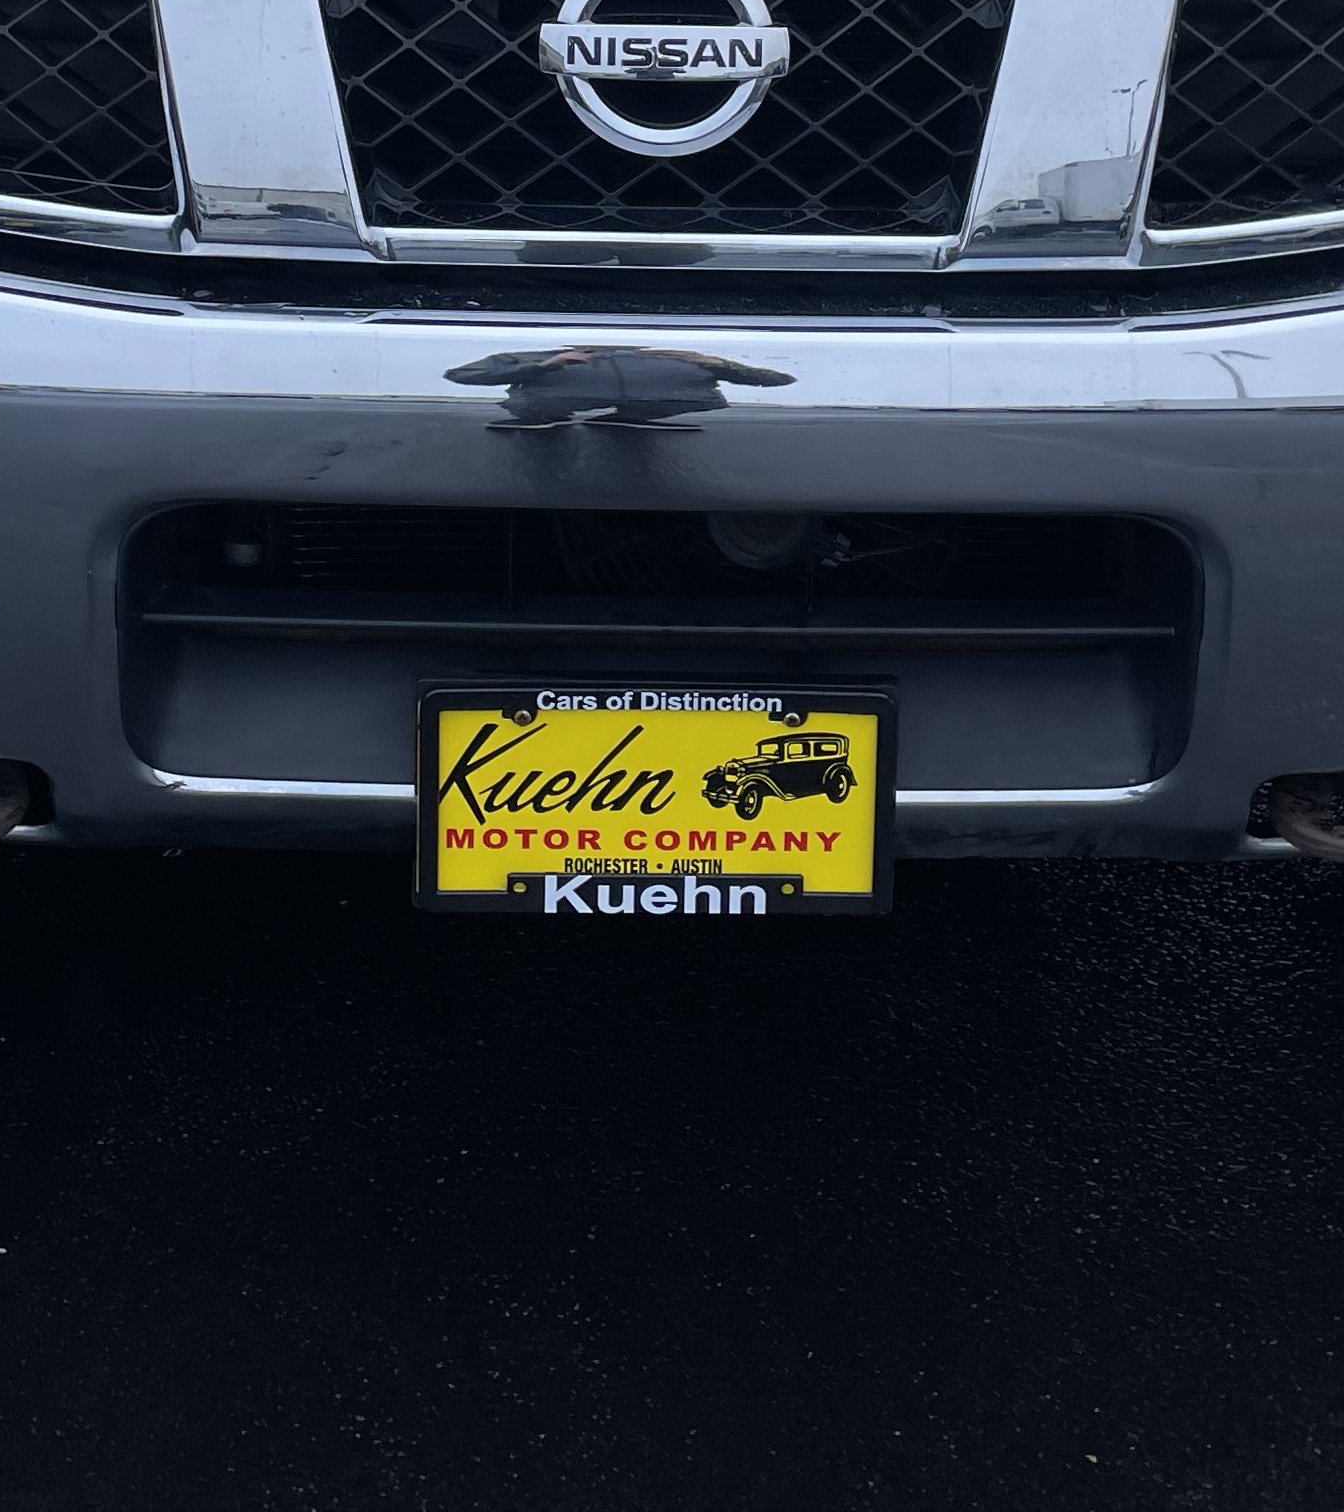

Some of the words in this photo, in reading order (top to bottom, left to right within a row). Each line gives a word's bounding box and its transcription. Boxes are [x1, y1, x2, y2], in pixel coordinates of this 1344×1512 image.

[567, 35, 763, 68] NISSAN
[537, 691, 599, 711] Cars
[605, 691, 633, 711] of
[640, 691, 783, 713] Distinction
[438, 723, 676, 825] Kuehn
[446, 828, 602, 850] MOTOR
[624, 830, 842, 852] COMPANY
[564, 858, 648, 875] ROCHESTER
[671, 858, 723, 875] AUSTIN
[544, 875, 767, 915] Kuehn
